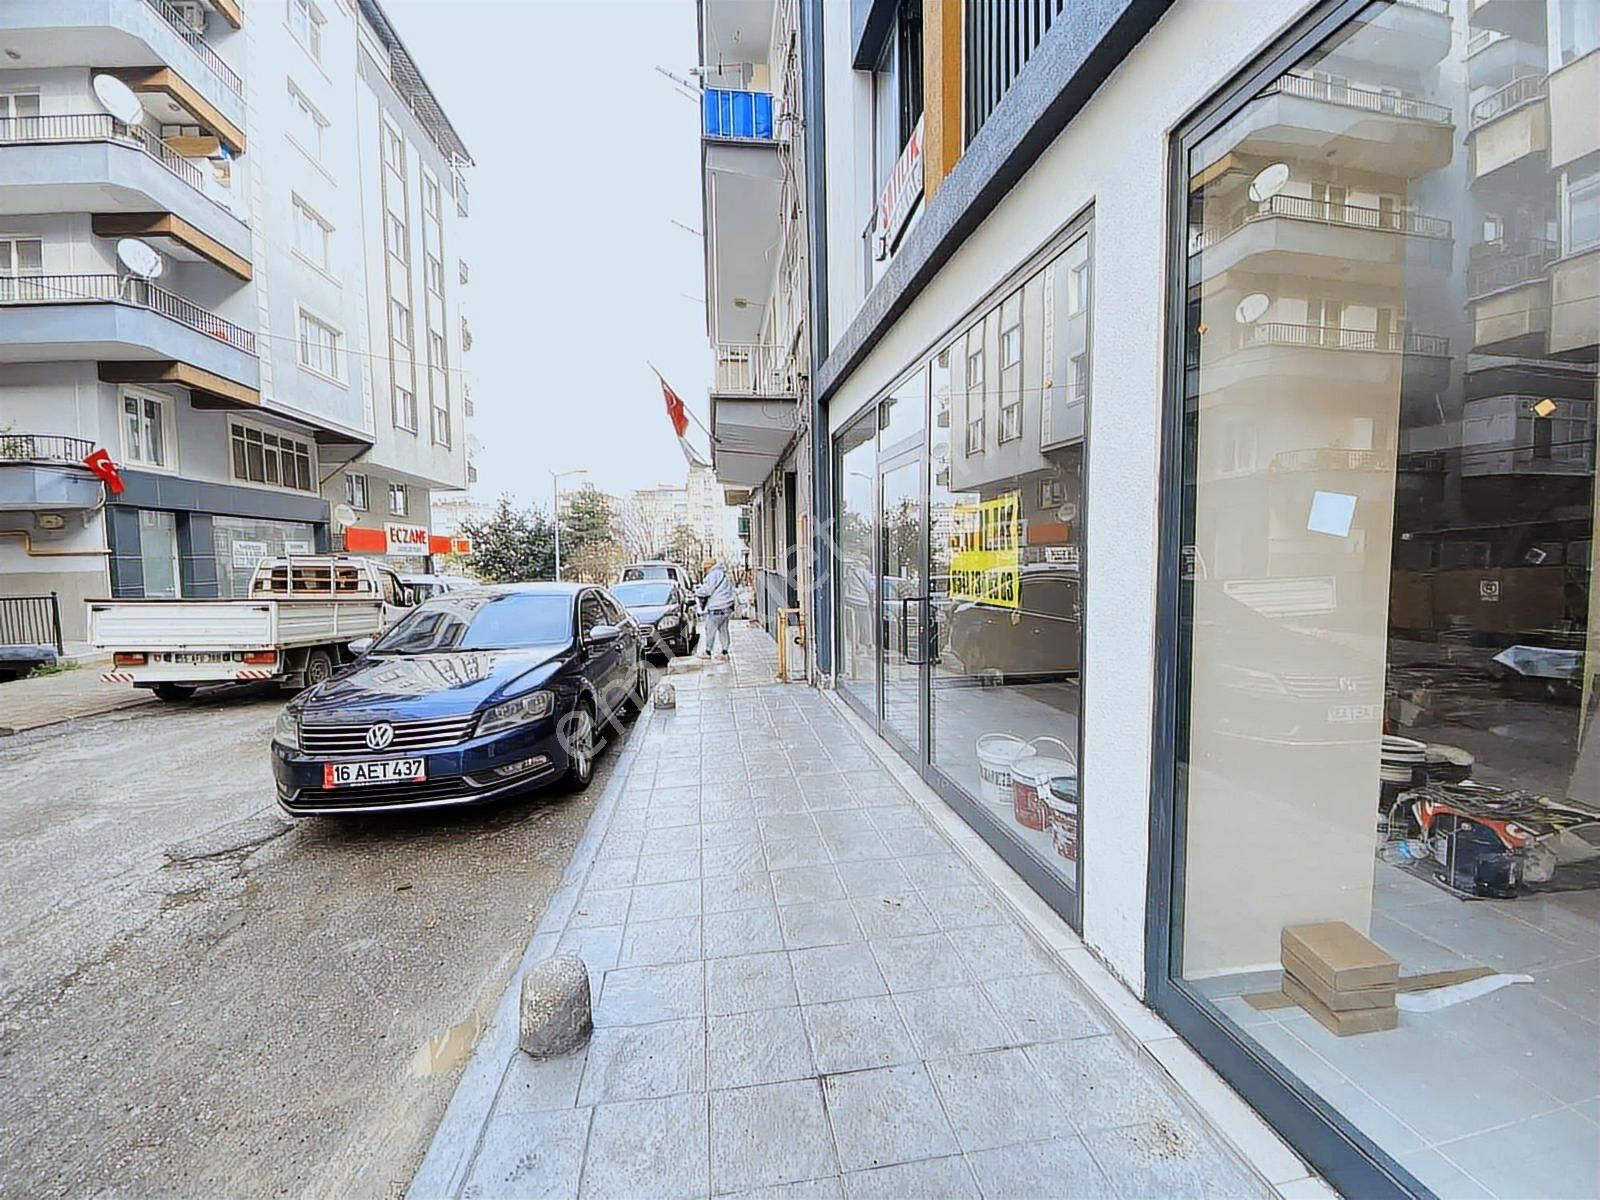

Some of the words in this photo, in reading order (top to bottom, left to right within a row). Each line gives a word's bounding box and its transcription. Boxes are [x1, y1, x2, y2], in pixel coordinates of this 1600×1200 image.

[389, 526, 427, 544] ECZANE
[334, 765, 350, 782] 16
[355, 763, 390, 780] AET
[392, 760, 422, 777] 437
